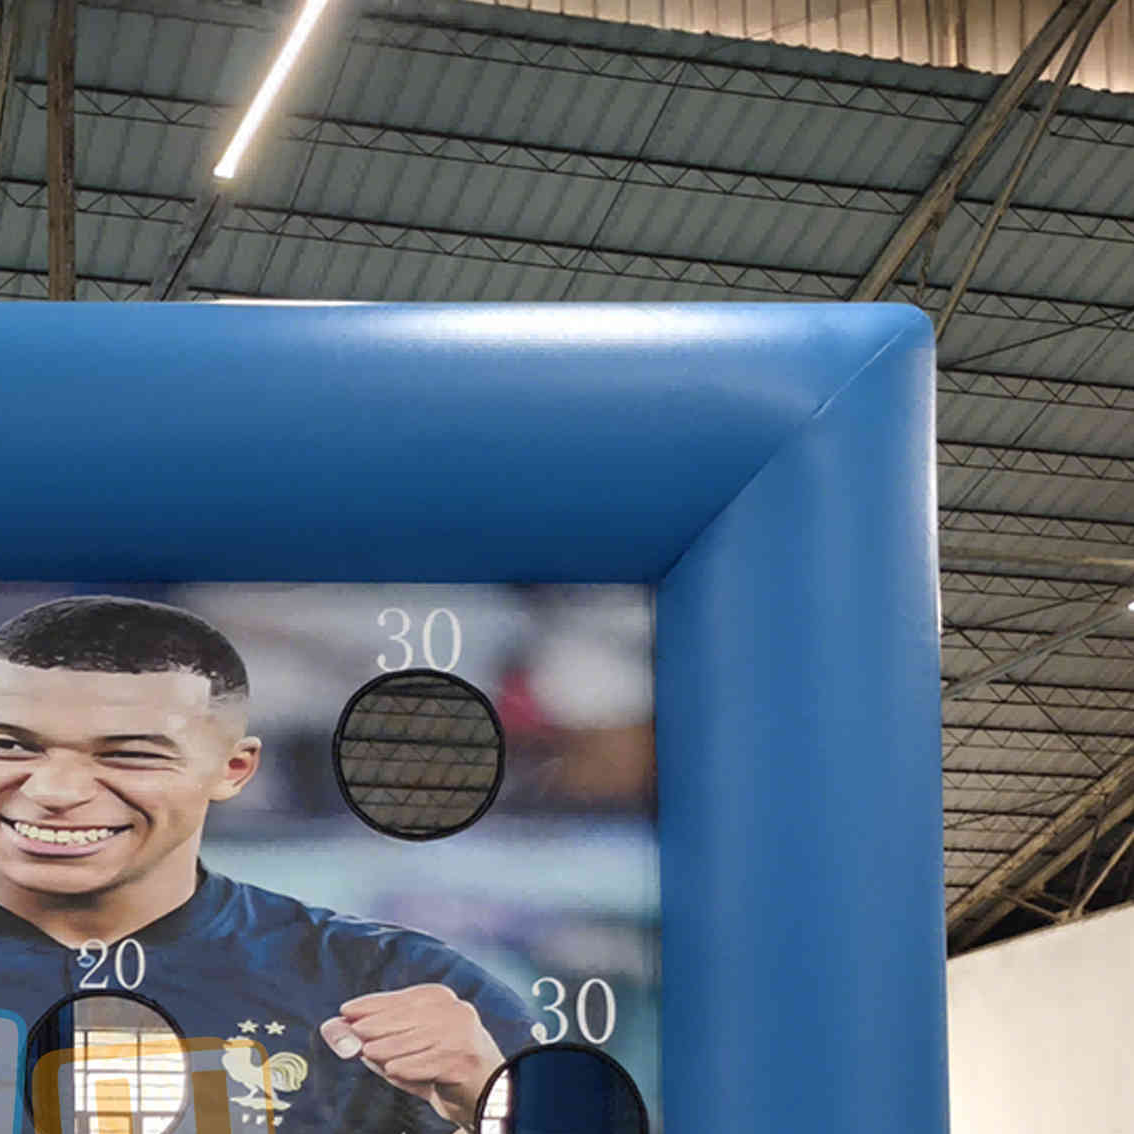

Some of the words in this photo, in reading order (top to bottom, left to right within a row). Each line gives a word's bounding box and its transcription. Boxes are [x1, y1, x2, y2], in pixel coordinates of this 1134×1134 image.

[377, 607, 461, 672] 30
[76, 938, 146, 990] 20
[530, 977, 616, 1044] 30
